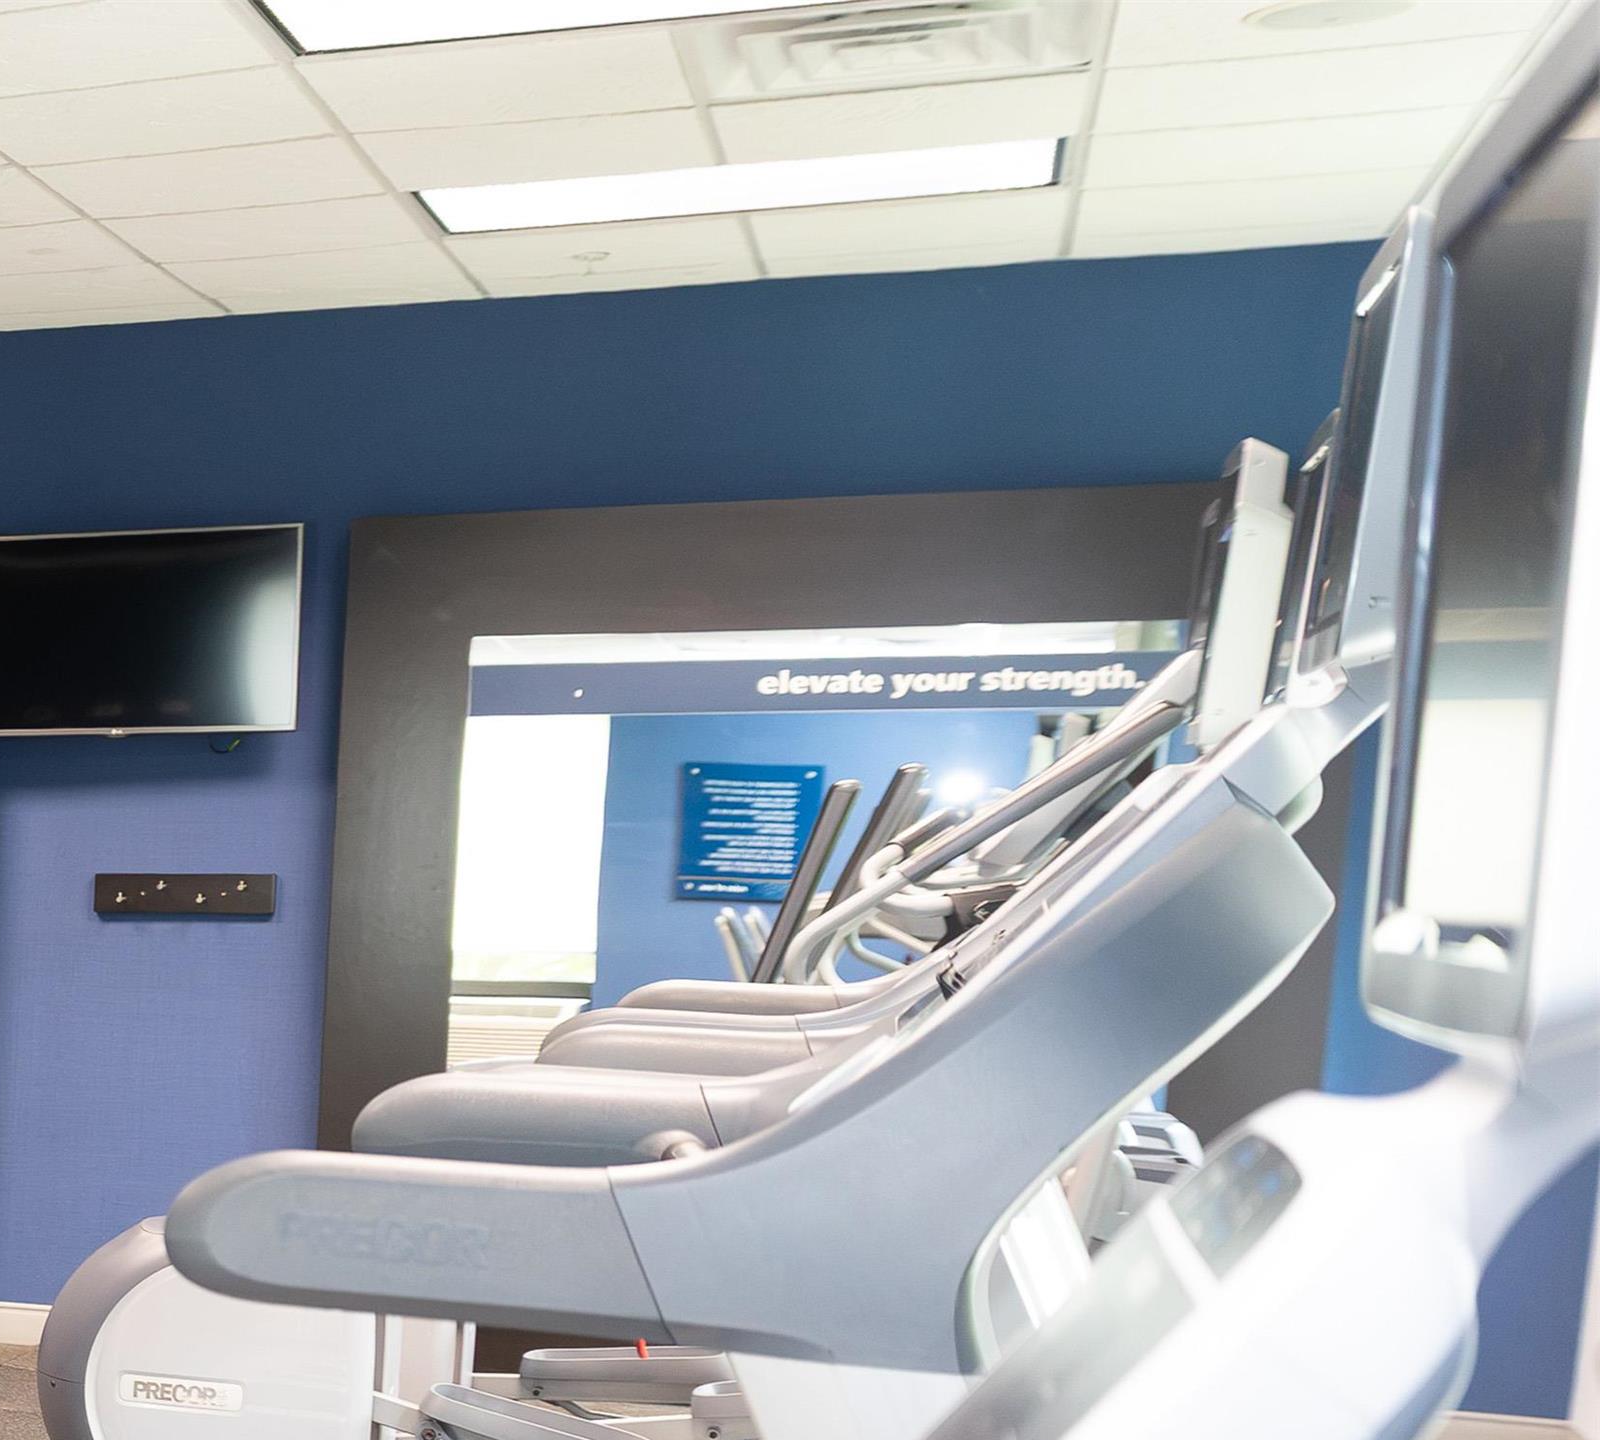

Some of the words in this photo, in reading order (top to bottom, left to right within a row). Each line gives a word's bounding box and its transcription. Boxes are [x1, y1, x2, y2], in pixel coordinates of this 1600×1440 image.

[757, 669, 884, 695] elevate
[890, 670, 976, 699] your
[979, 663, 1146, 697] strength.
